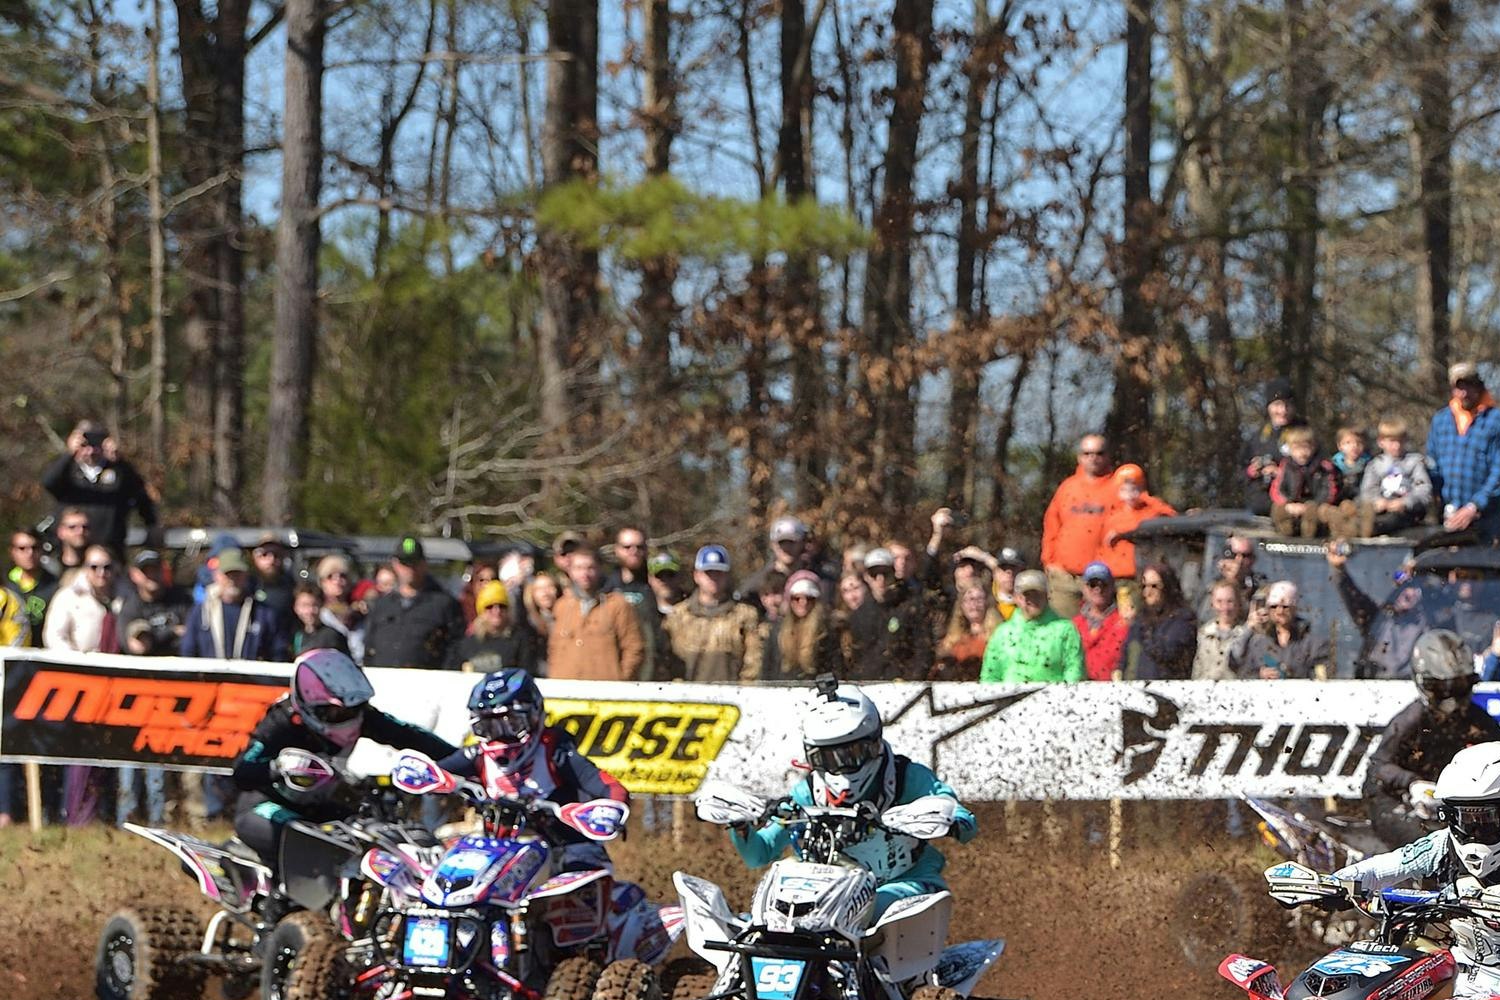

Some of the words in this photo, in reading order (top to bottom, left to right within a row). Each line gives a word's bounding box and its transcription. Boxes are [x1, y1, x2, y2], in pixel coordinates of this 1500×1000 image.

[13, 670, 290, 735] MOOS
[556, 713, 718, 761] OOSE
[757, 964, 801, 993] 93
